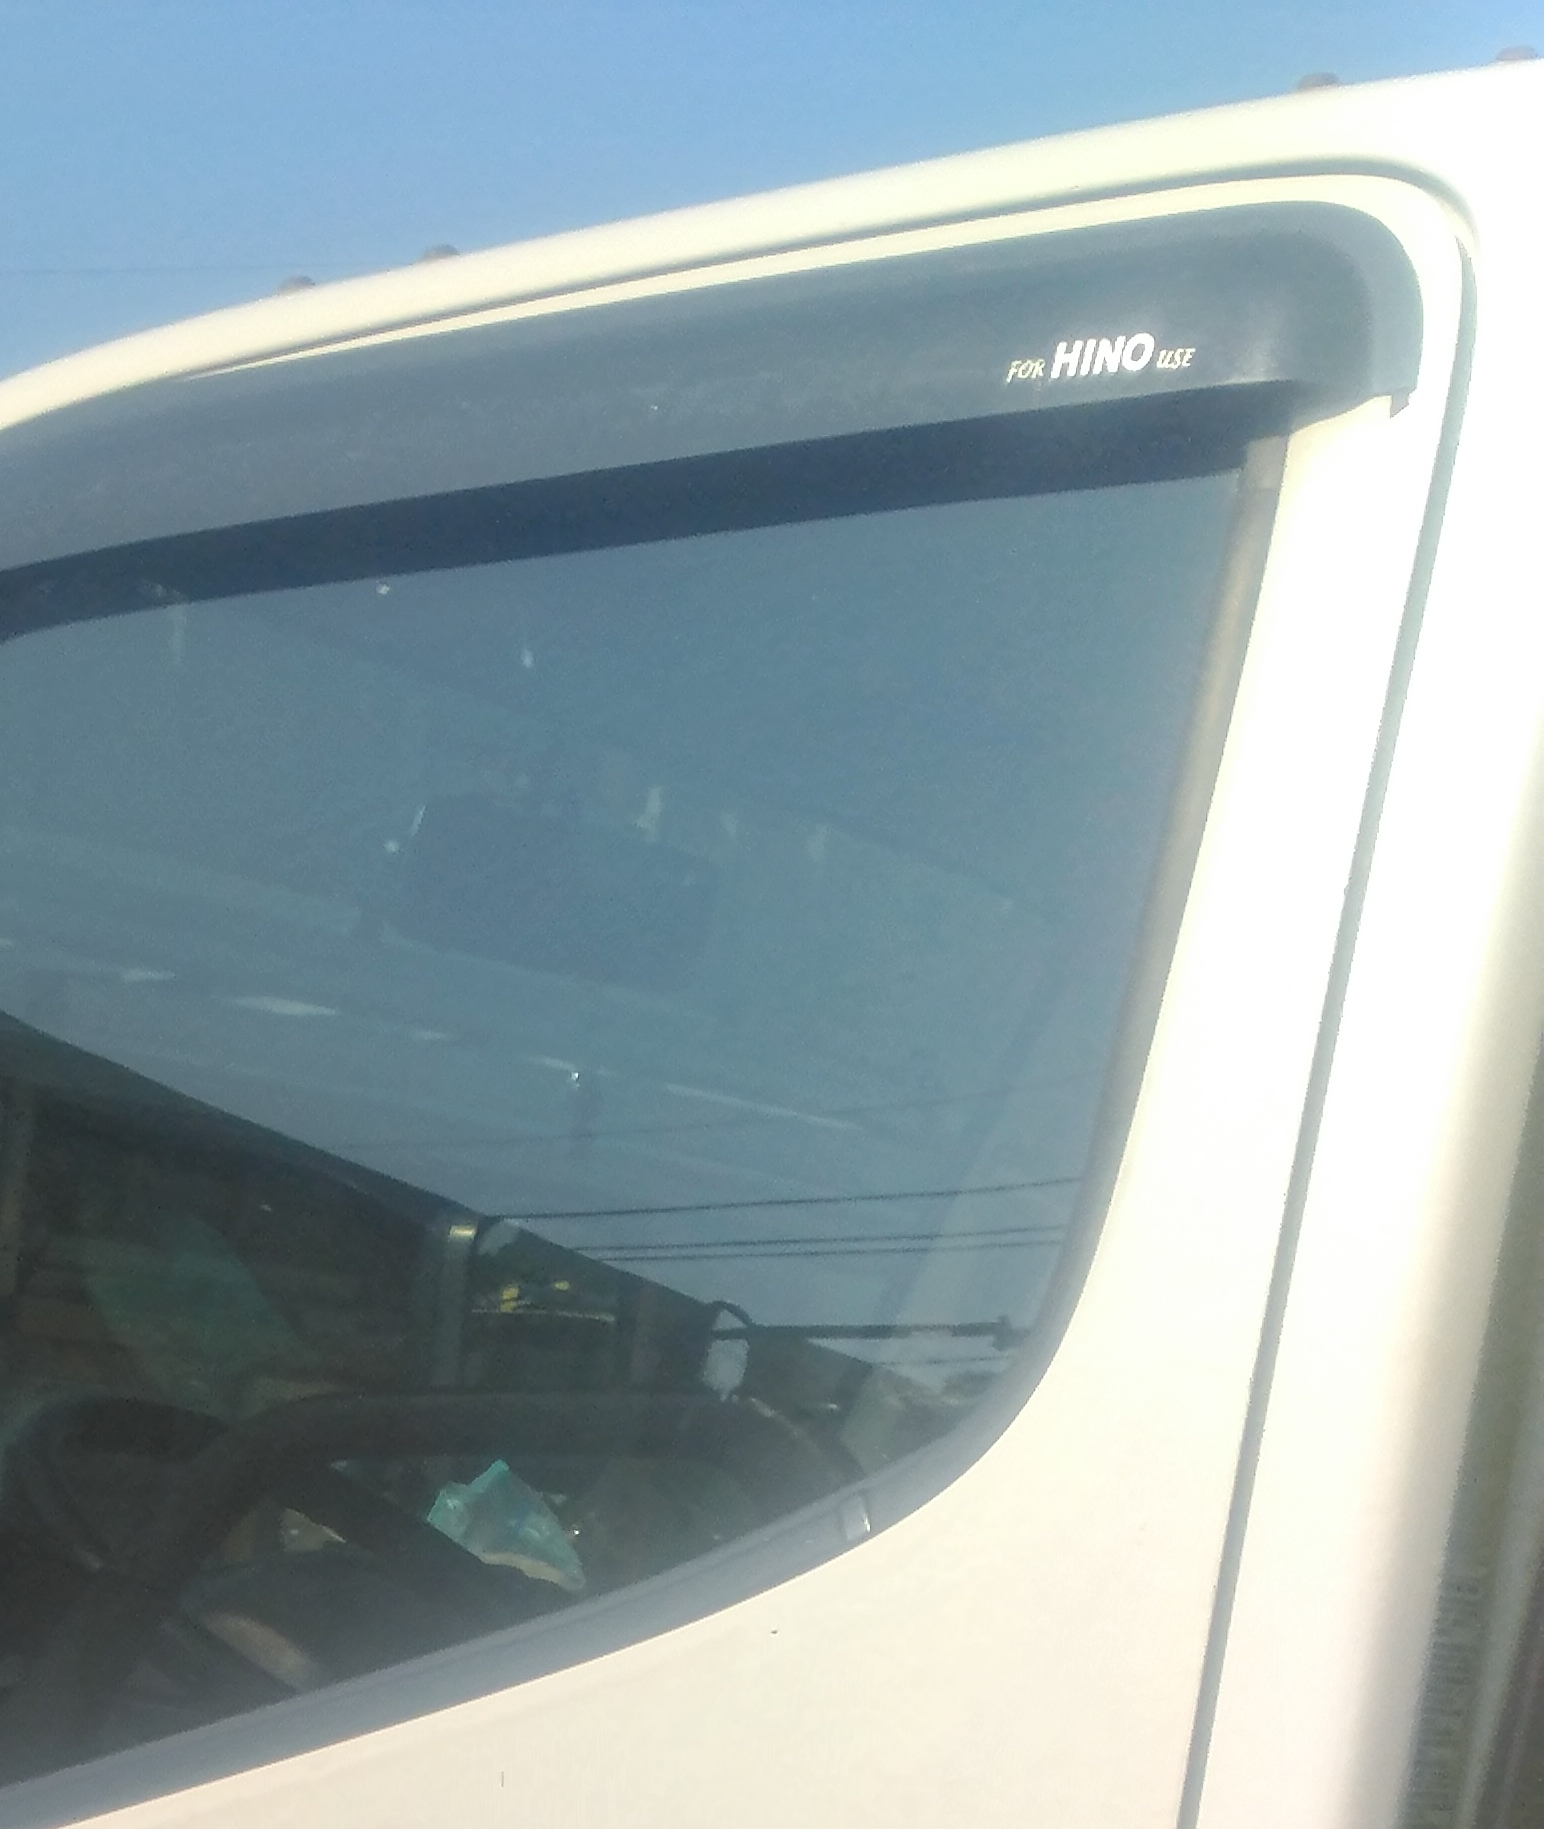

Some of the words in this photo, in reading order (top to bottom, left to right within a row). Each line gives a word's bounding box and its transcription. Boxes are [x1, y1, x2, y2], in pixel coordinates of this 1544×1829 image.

[1006, 359, 1045, 382] FOR
[1051, 333, 1155, 378] HINO
[1157, 348, 1196, 369] USE
